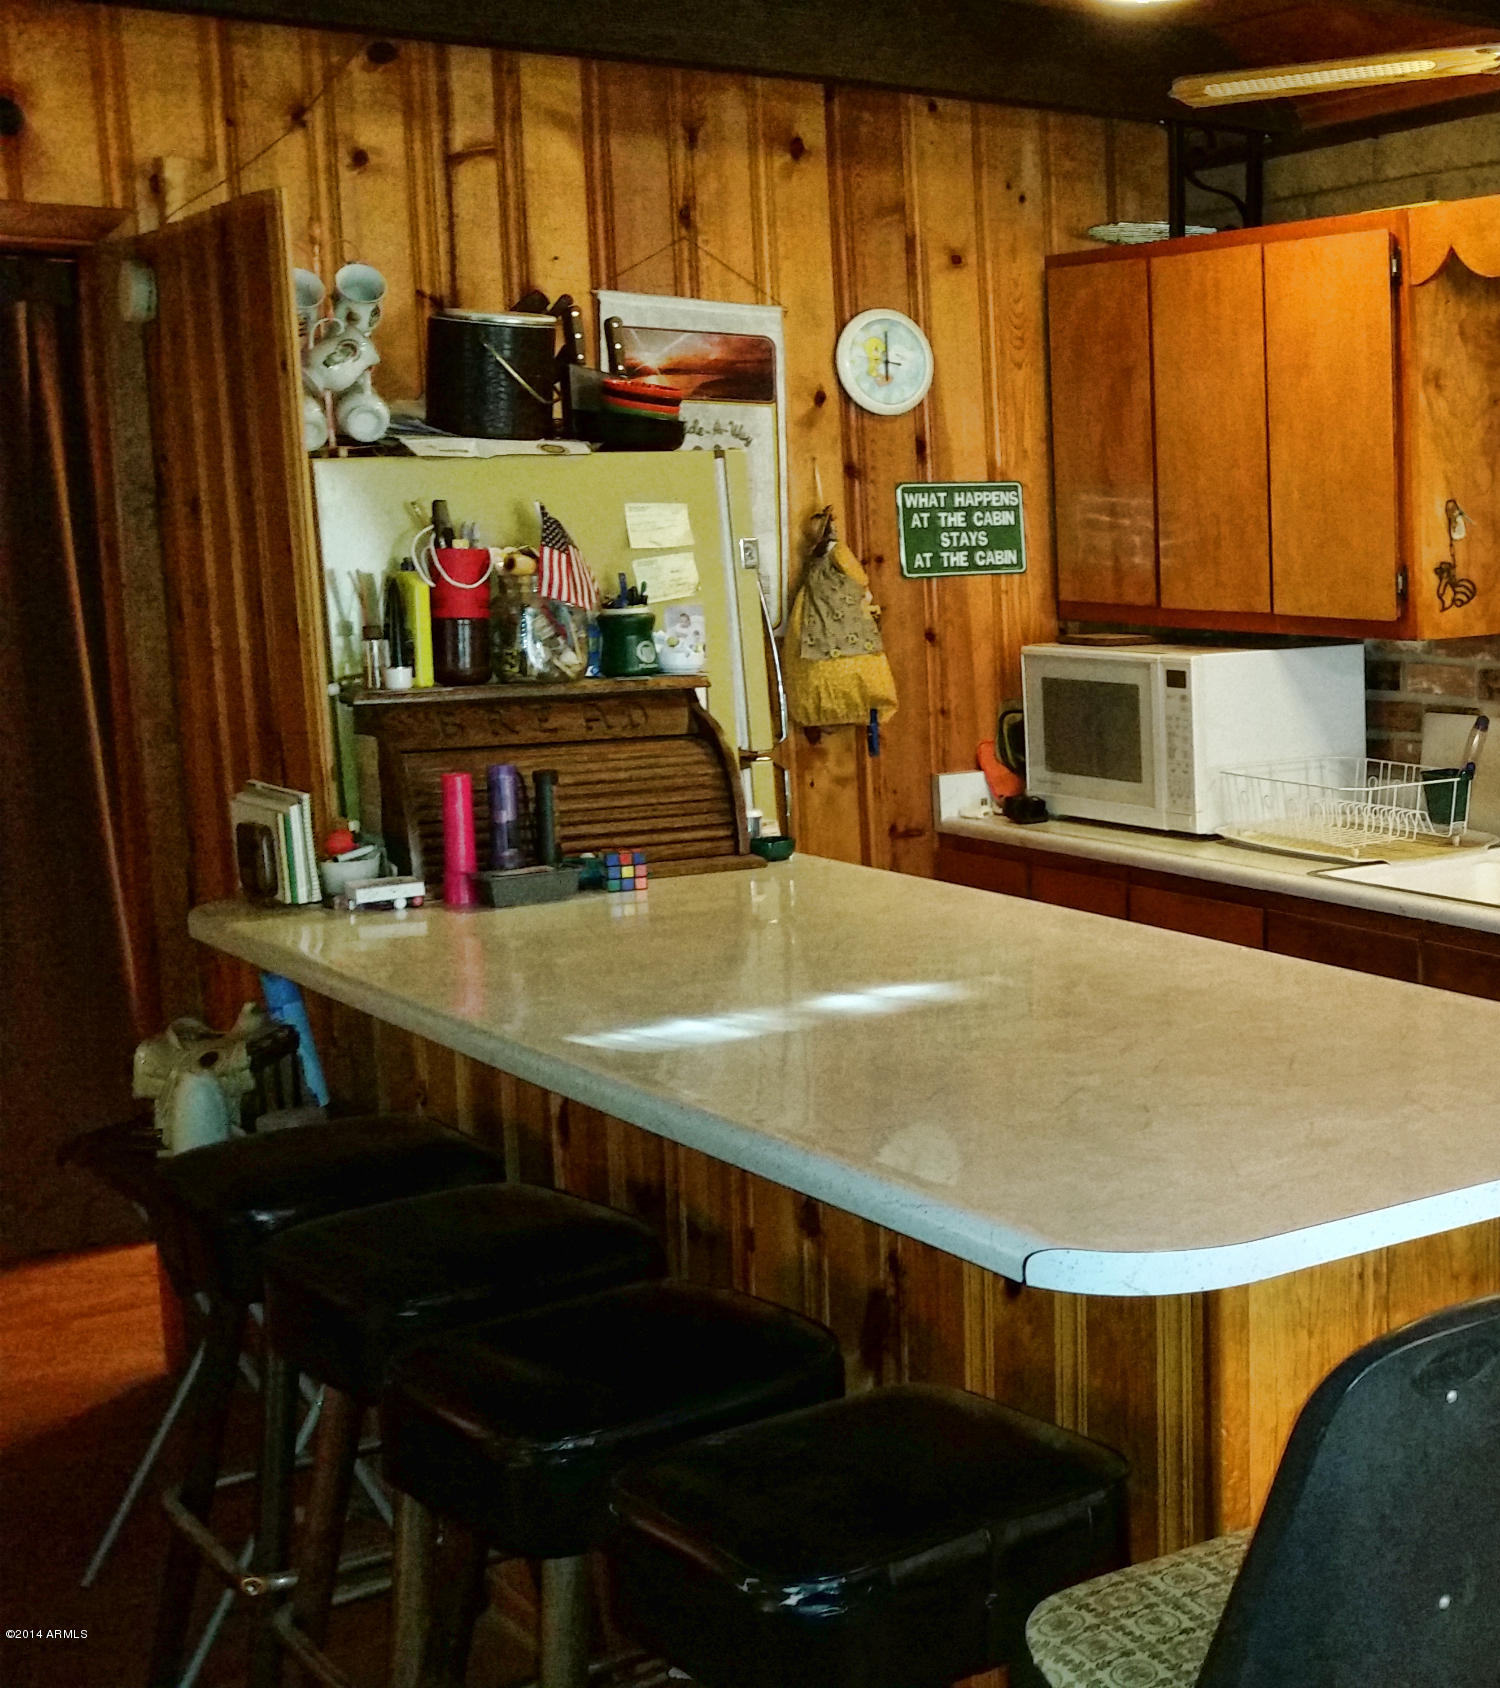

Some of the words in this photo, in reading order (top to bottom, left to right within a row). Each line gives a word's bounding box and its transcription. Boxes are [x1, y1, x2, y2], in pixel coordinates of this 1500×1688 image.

[904, 492, 947, 508] WHAT
[953, 490, 1019, 508] HAPPENS
[910, 512, 931, 528] AT
[937, 511, 967, 527] THE
[973, 510, 1016, 526] CABIN
[939, 531, 989, 547] STAYS
[913, 552, 934, 568] AT
[940, 551, 969, 567] THE
[975, 549, 1017, 566] CABIN
[436, 700, 650, 739] BREAD
